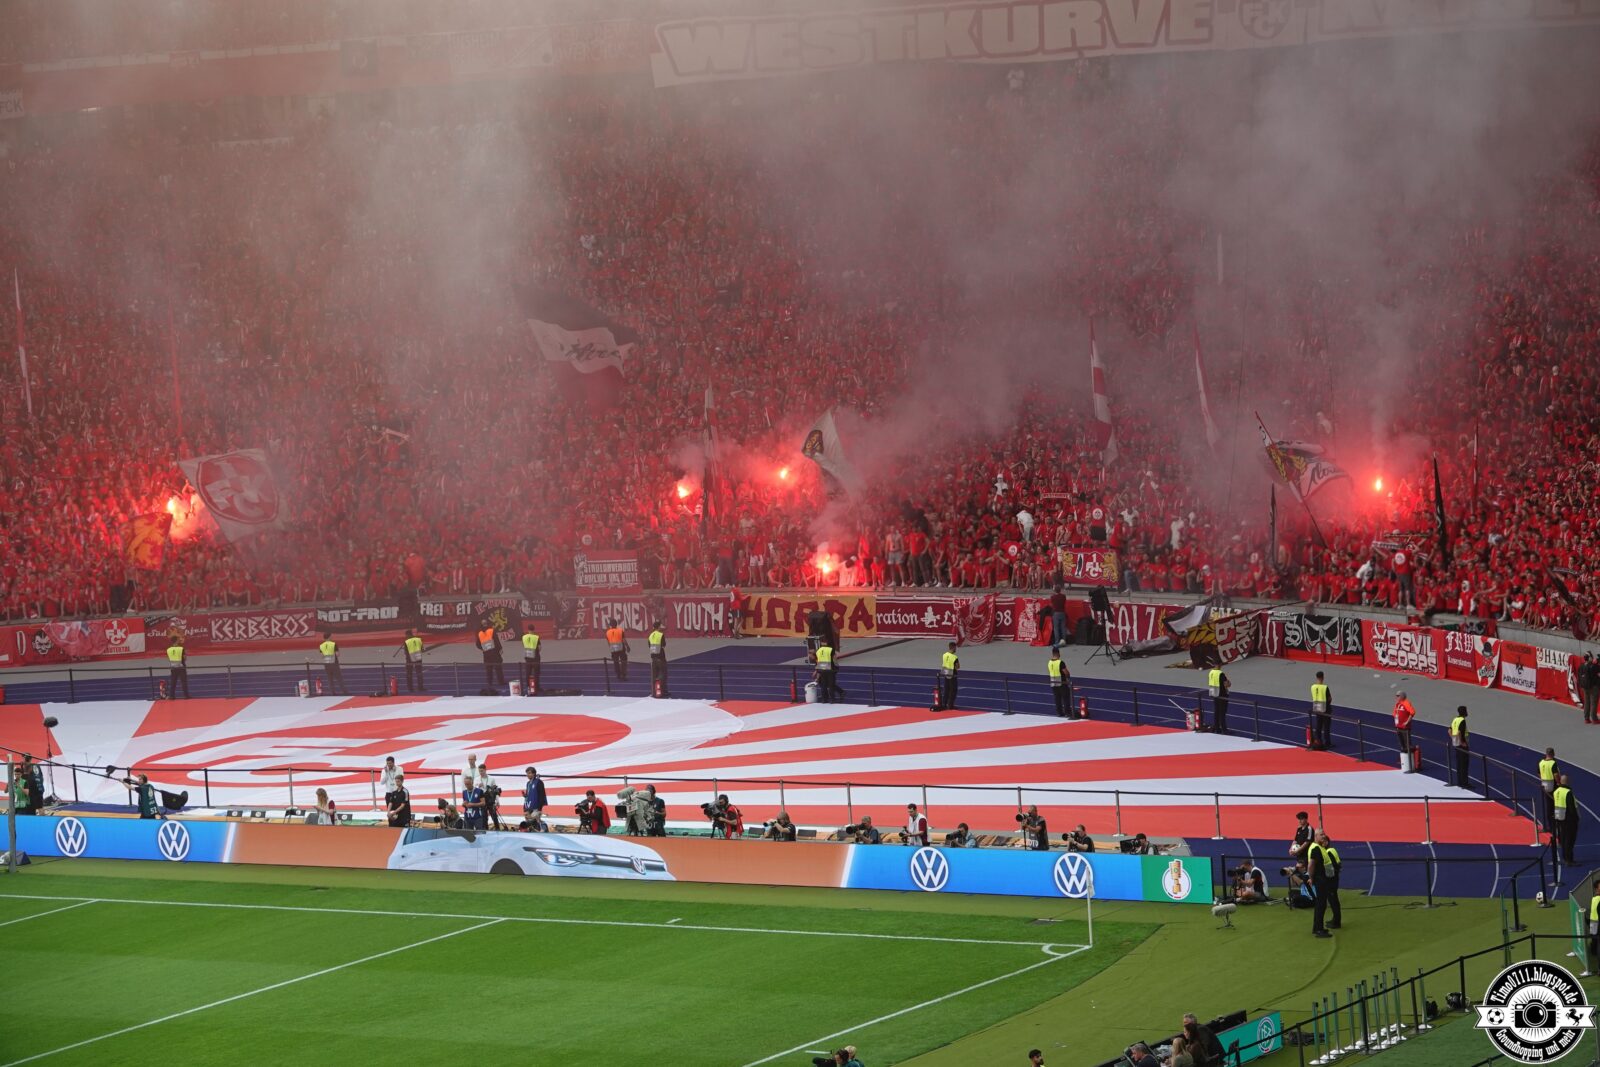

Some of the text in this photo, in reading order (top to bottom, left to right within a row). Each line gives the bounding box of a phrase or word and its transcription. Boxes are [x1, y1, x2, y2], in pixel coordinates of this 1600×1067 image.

[659, 0, 1214, 76] WESTKURVE
[673, 601, 724, 631] YOUTH
[910, 846, 949, 892] VW
